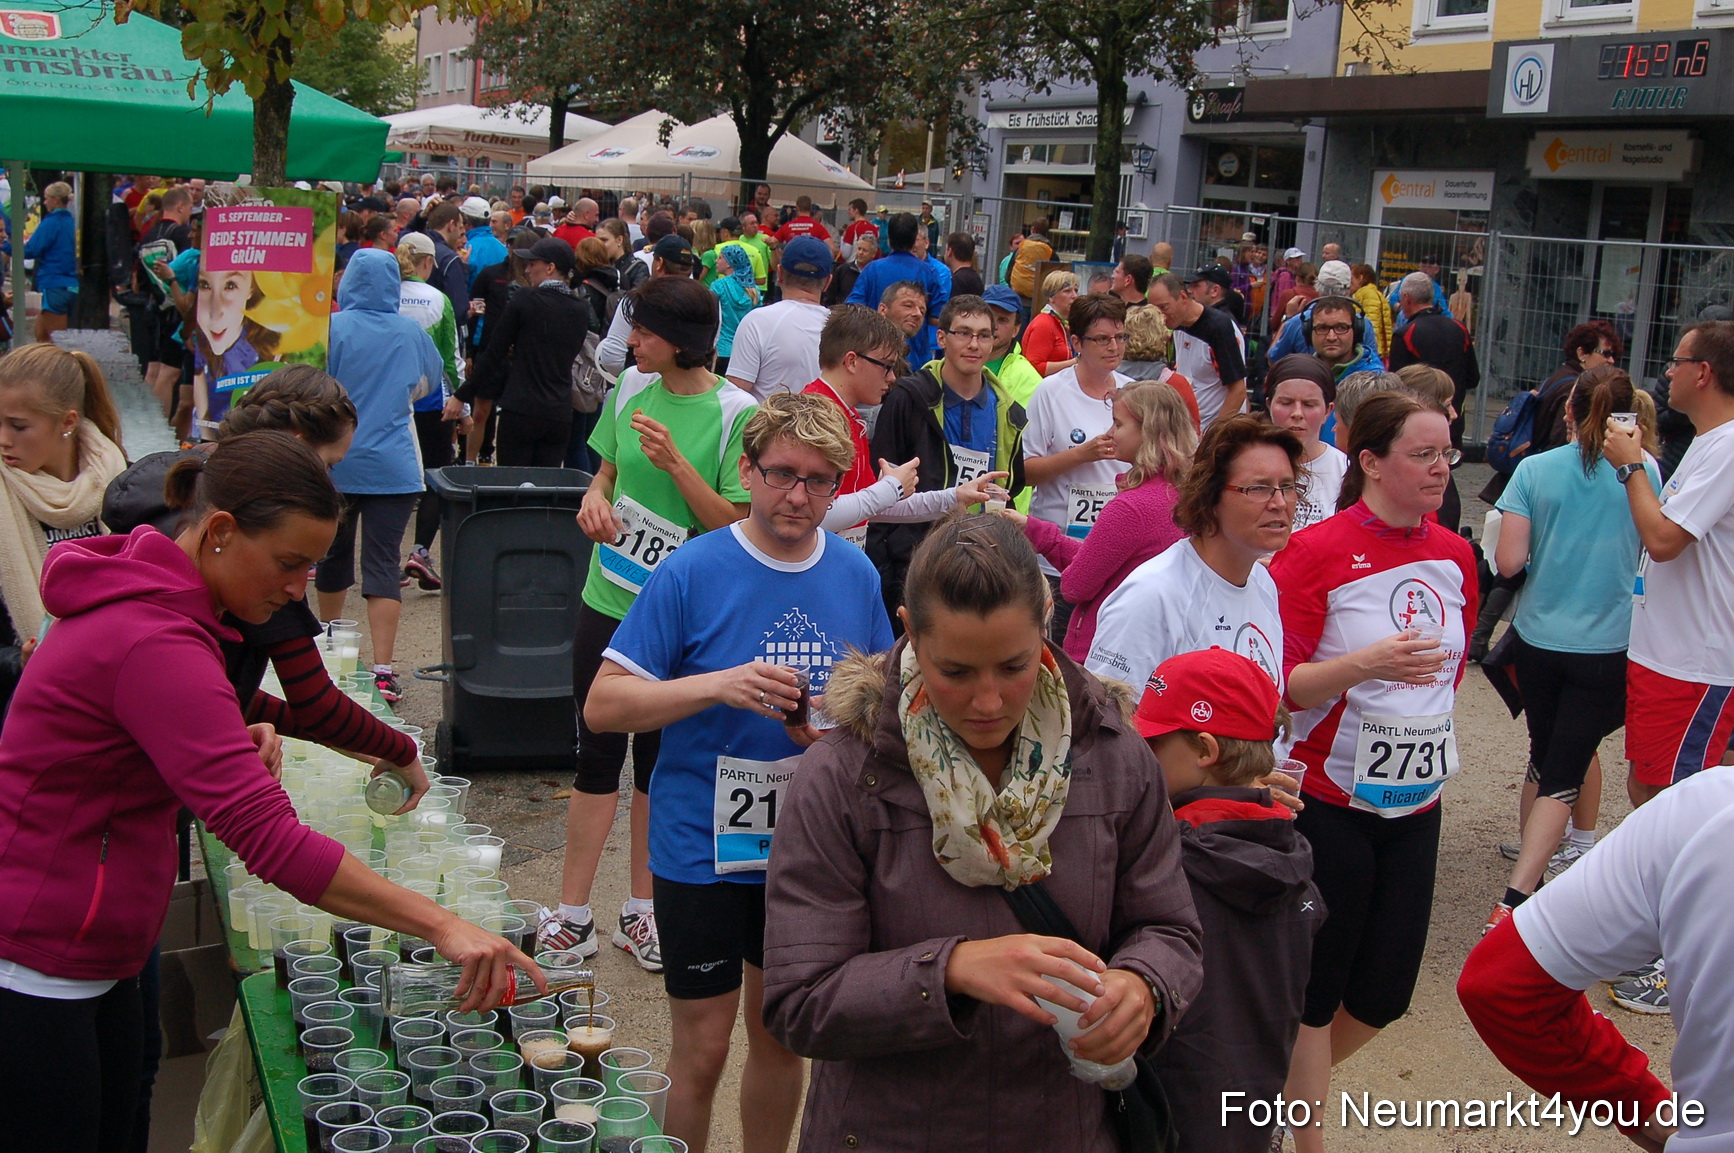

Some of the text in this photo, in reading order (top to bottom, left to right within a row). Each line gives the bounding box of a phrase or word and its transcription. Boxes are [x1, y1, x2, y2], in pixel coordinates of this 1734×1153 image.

[0, 45, 132, 62] markter
[1611, 86, 1689, 109] RITTER
[1008, 111, 1098, 127] Eis Frühstück Snac
[463, 129, 520, 146] Tucher
[1556, 142, 1612, 166] Central
[1623, 143, 1673, 151] Kosmetik- und
[1622, 155, 1664, 165] Nagelstudio
[1390, 180, 1436, 199] Central
[1444, 180, 1477, 188] Dauerhafte
[1444, 191, 1487, 201] Haarentfernung
[218, 213, 228, 223] 15.
[228, 211, 283, 223] SEPTEMBER
[209, 230, 307, 247] BEIDE STIMMEN
[231, 246, 266, 264] GRÜN
[237, 376, 250, 385] IST
[953, 453, 988, 466] Neumarkt
[1071, 489, 1094, 497] PARTL
[641, 517, 681, 542] Neumarkt
[1194, 709, 1210, 718] FCN
[1362, 722, 1444, 737] PARTL Neumarkt
[1367, 737, 1447, 780] 2731
[720, 768, 763, 784] PARTL
[728, 787, 777, 829] 21
[759, 839, 770, 854] P
